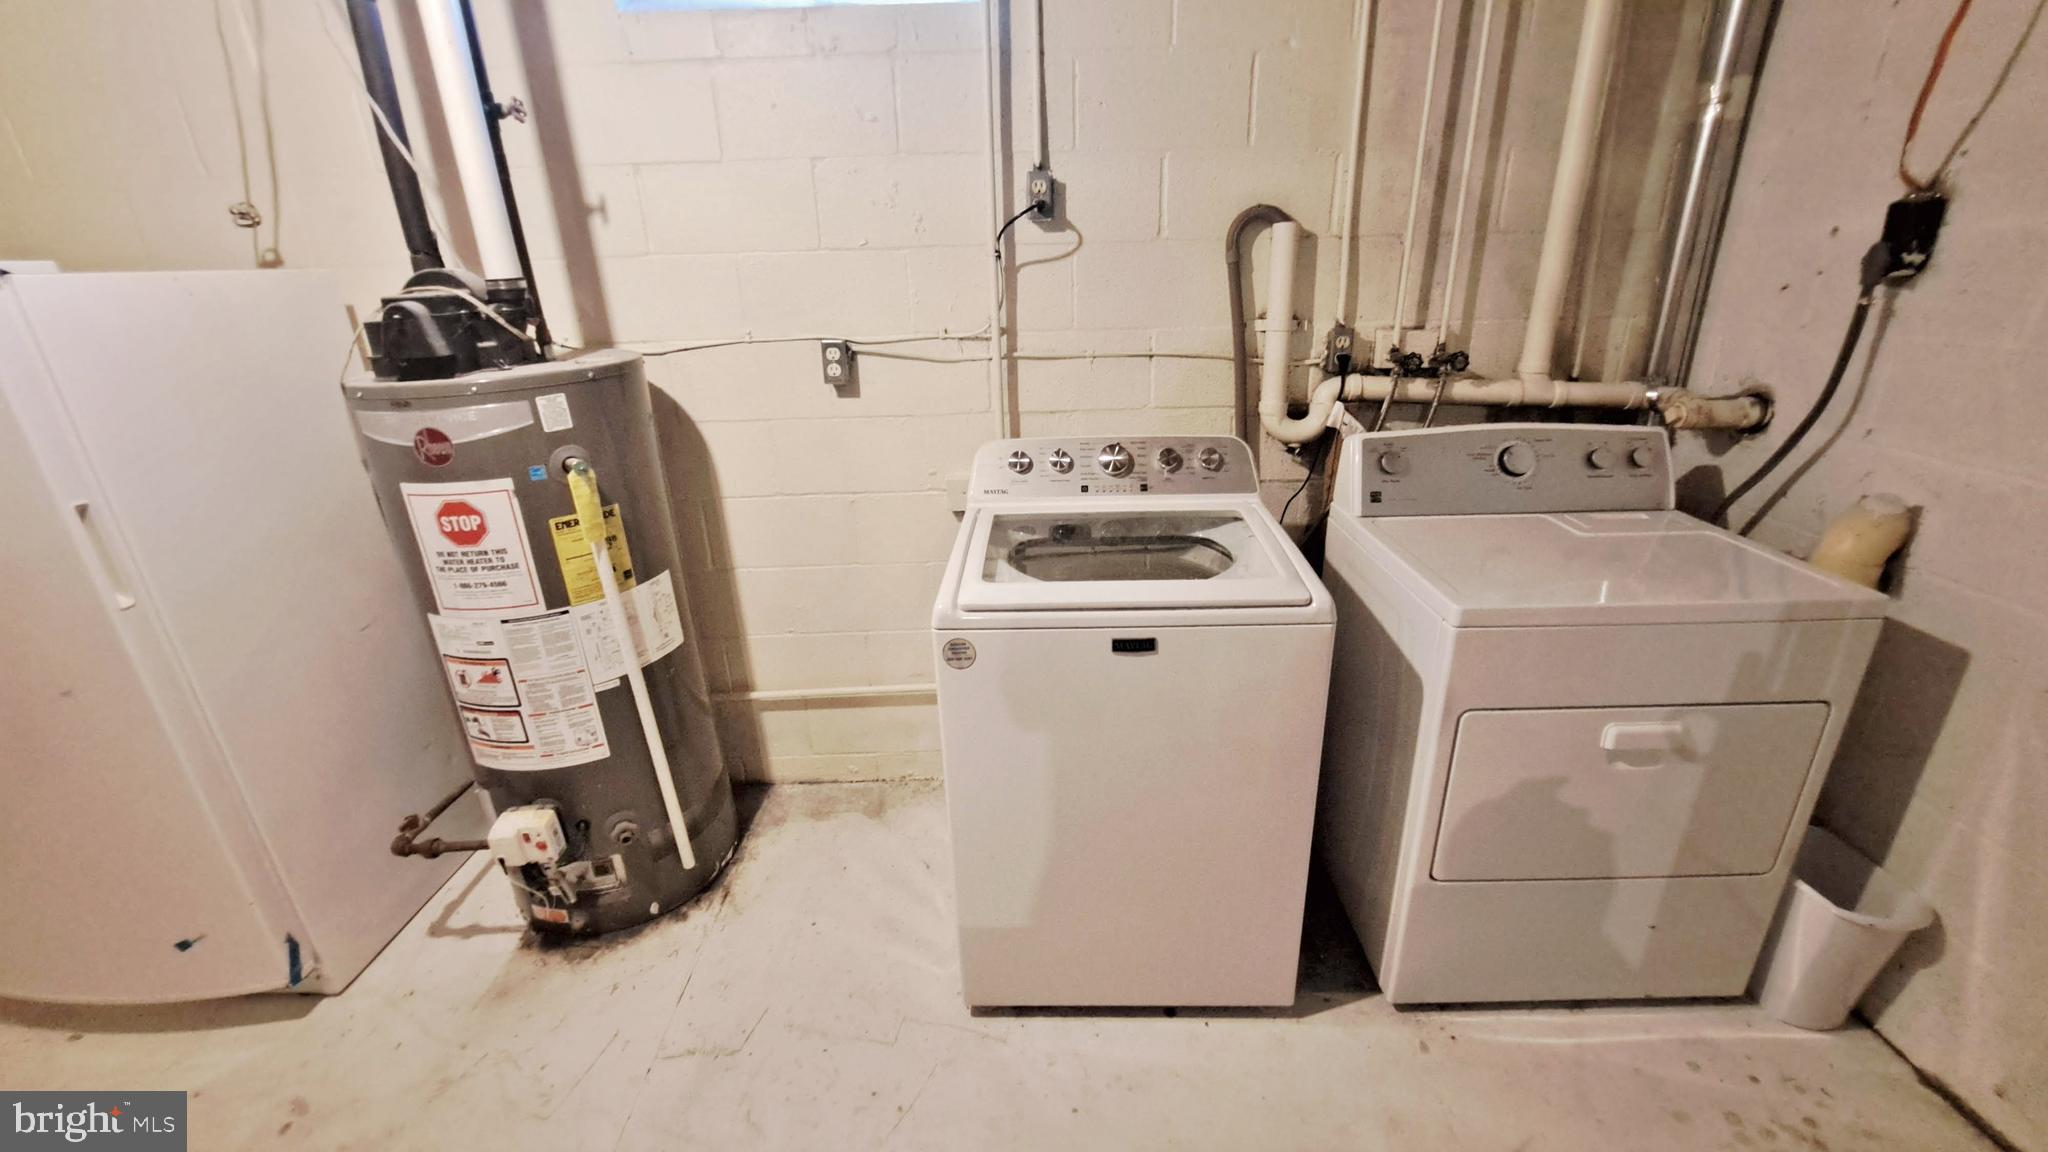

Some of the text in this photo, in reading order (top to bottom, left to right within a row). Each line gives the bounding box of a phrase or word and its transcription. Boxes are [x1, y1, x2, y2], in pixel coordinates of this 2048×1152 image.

[440, 515, 482, 532] STOP
[466, 557, 493, 565] HEATER
[481, 562, 519, 572] PURCHASE
